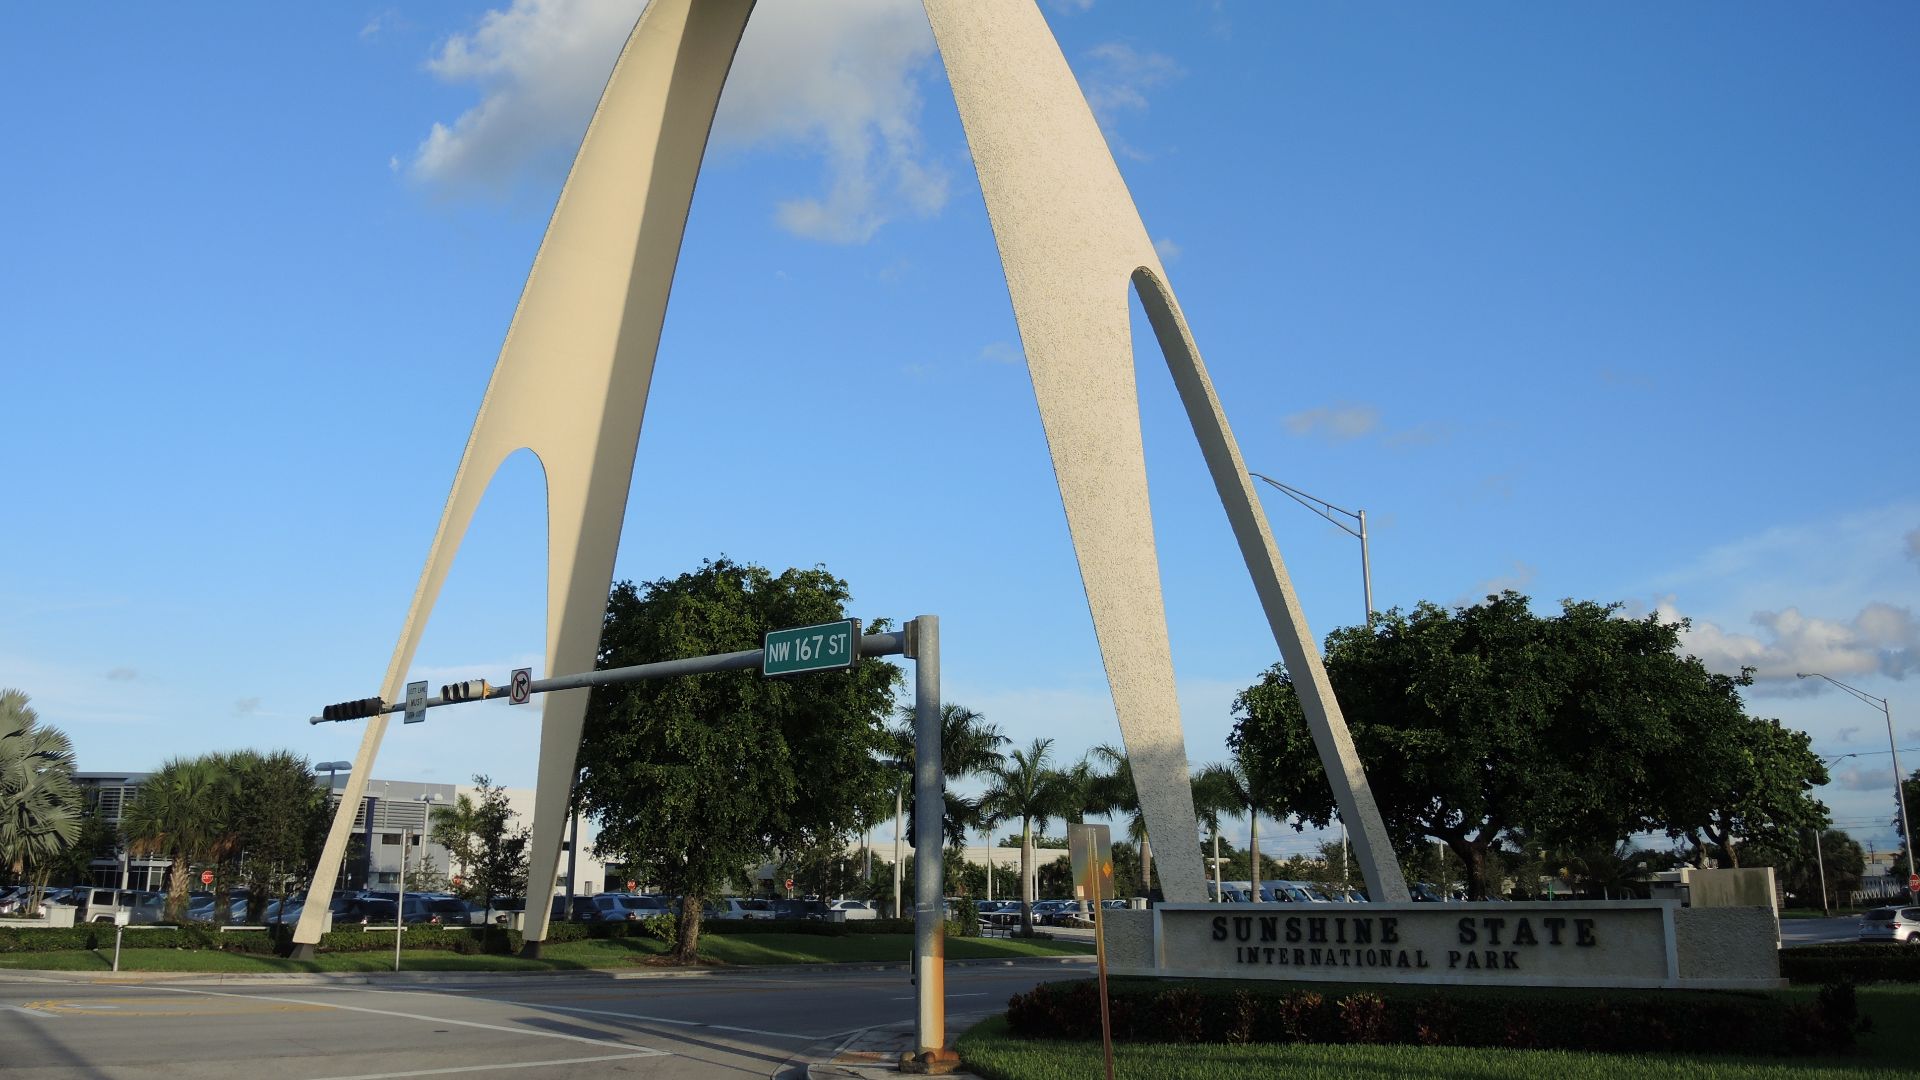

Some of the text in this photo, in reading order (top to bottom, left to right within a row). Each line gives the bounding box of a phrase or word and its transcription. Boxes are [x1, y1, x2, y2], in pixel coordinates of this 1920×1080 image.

[768, 633, 847, 663] NW 167 ST
[1212, 916, 1596, 947] SUNSHINE STATE
[1237, 947, 1520, 969] INTERNATIONAL PARK
